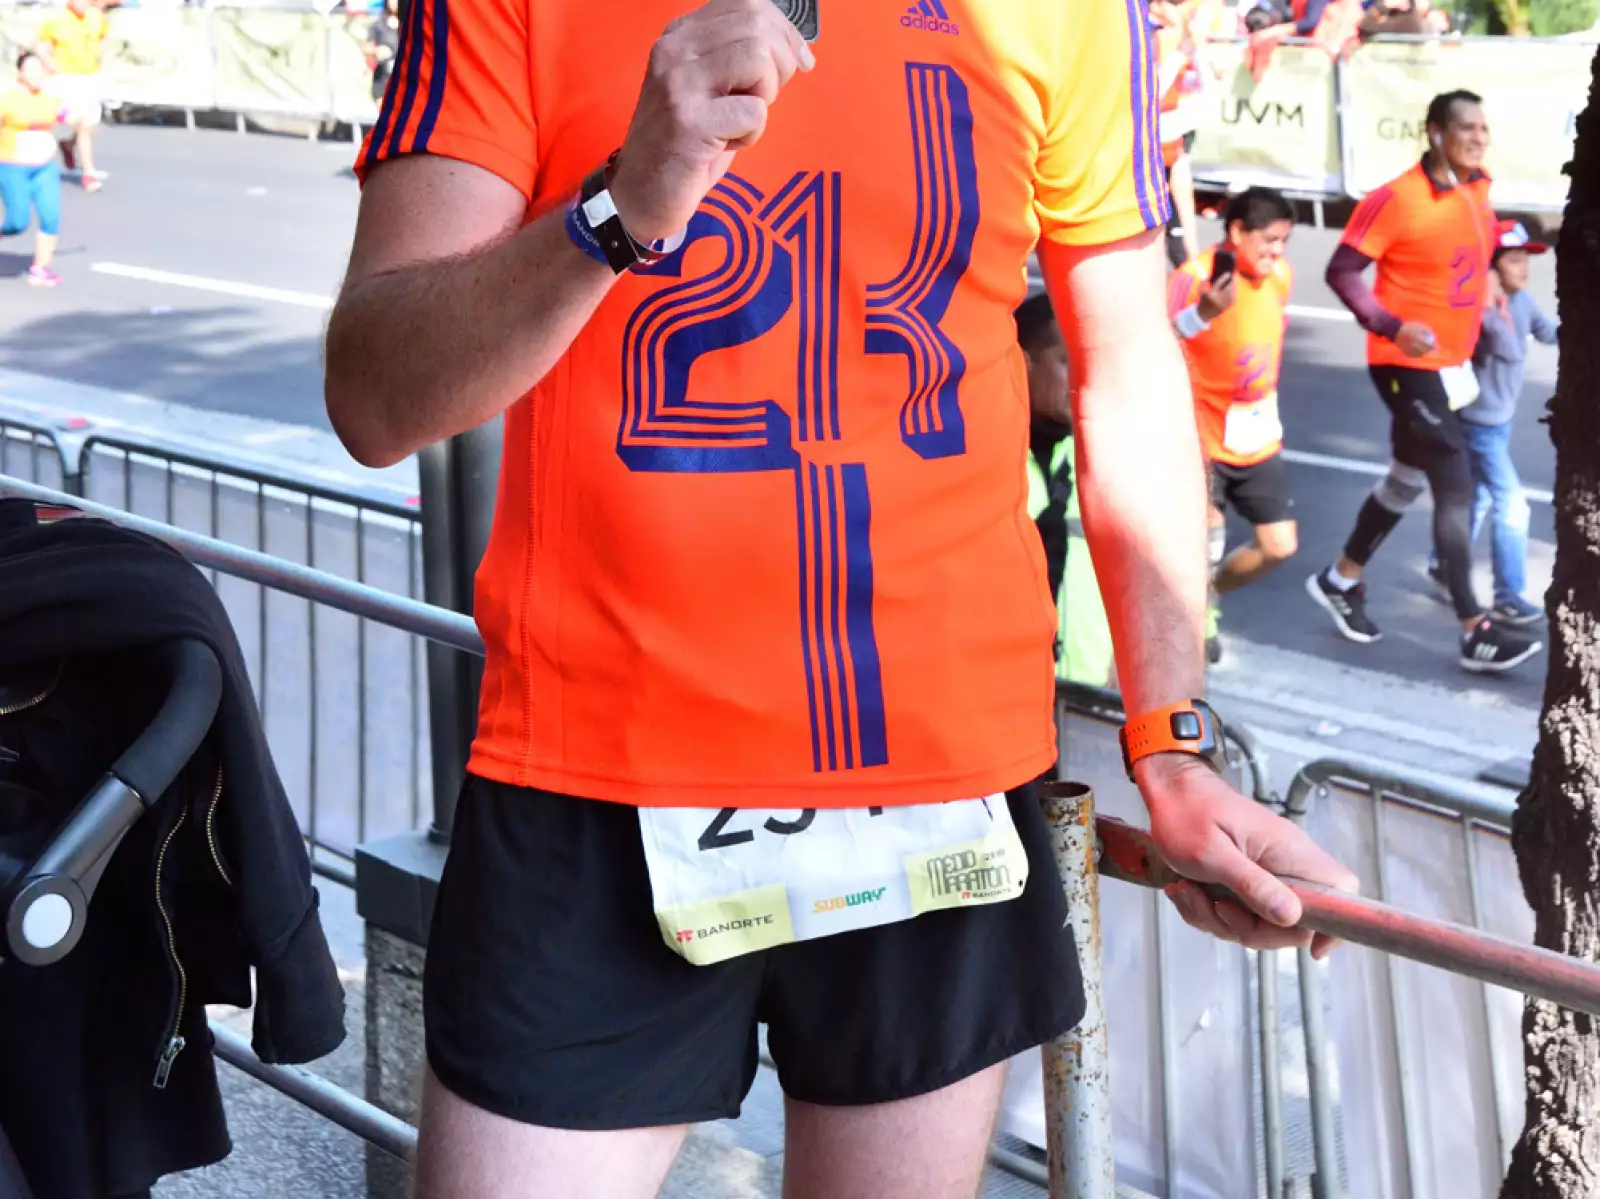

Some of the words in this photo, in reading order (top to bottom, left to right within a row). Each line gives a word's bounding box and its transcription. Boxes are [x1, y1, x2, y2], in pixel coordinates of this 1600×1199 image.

[899, 15, 960, 36] adidas
[1220, 98, 1304, 128] UVM
[812, 886, 887, 914] SUBWAY
[696, 913, 776, 940] BANORTE
